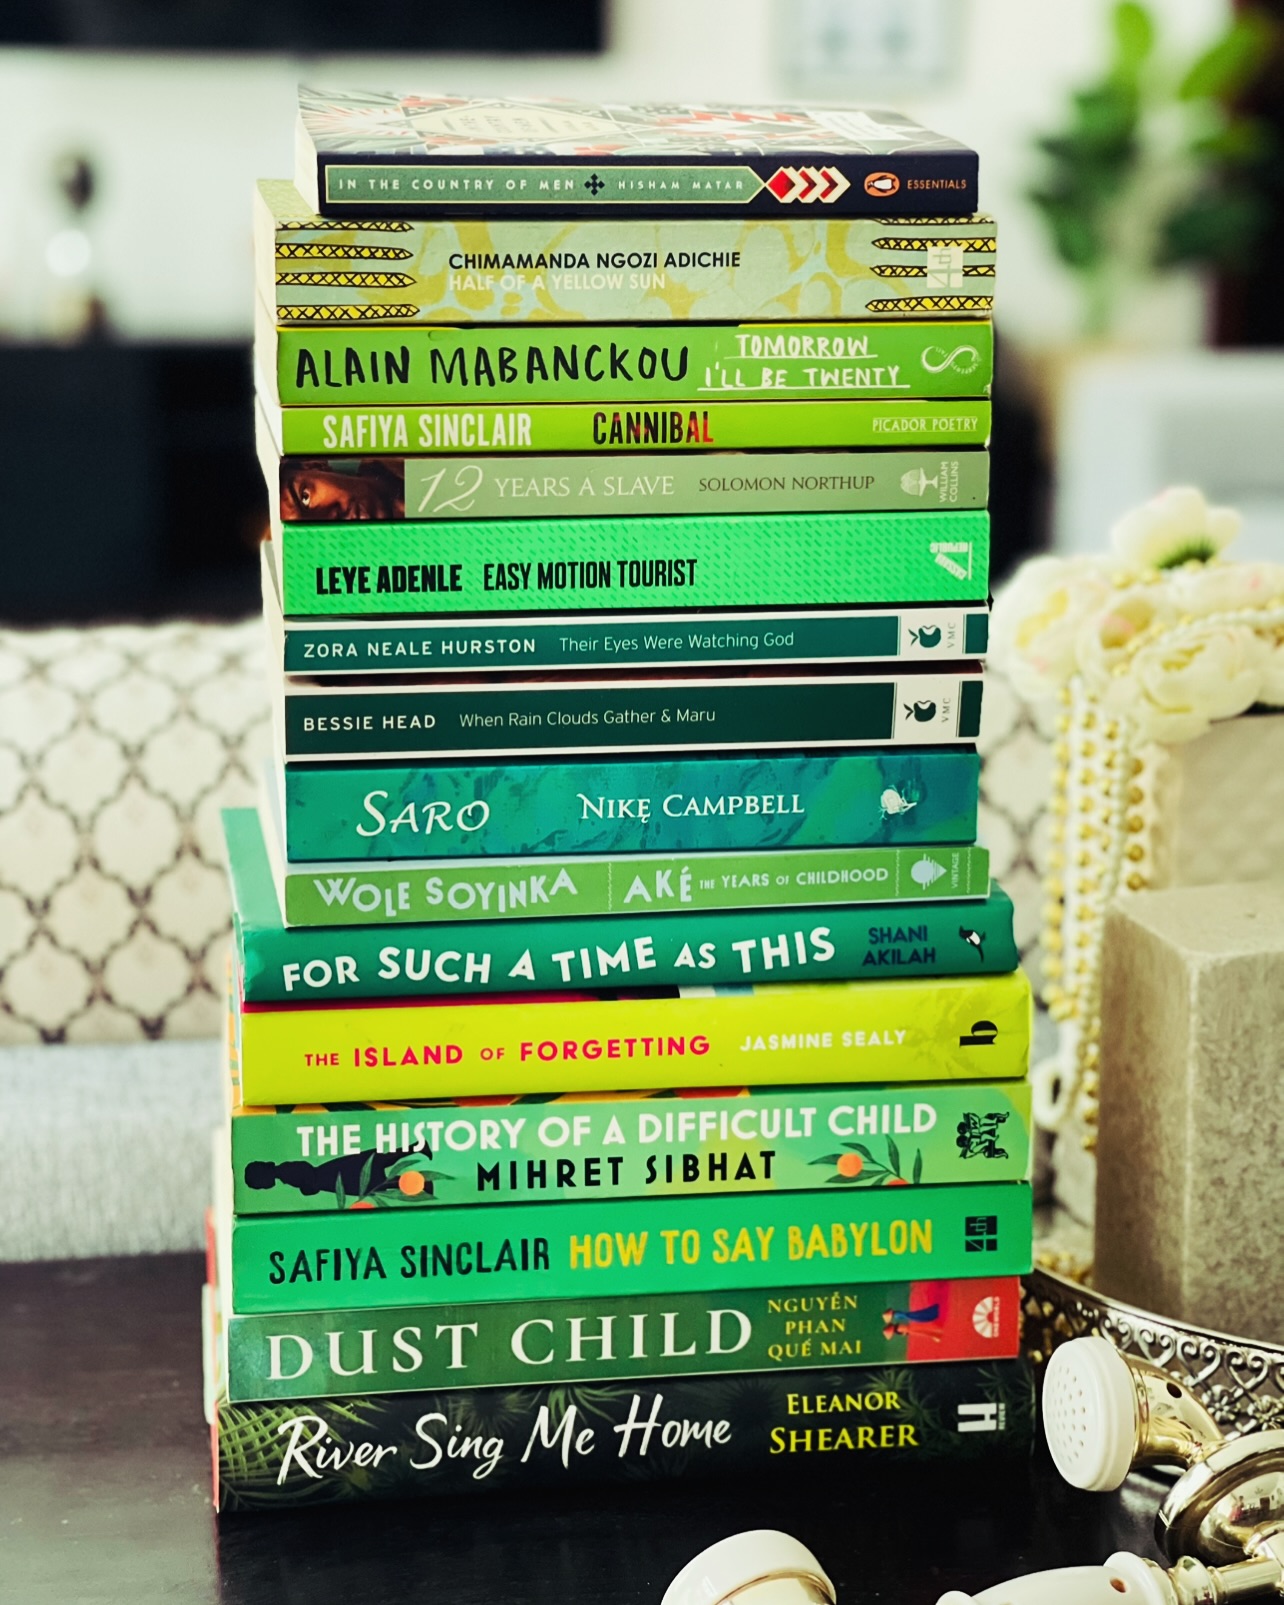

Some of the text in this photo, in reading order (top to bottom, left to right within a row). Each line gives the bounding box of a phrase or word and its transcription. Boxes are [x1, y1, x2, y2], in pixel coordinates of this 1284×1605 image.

[339, 179, 574, 190] IN THE COUNTRY OF MEN
[618, 180, 743, 190] HISHAM MATAR
[907, 180, 967, 190] ESSENTIALS
[448, 252, 741, 269] CHIMAMANDA NGOZI ADICHIE
[449, 273, 665, 291] HALF OF A YELLOW SUN
[734, 334, 868, 357] TOMORROW
[296, 342, 688, 388] ALAIN MABANCKOU
[705, 362, 900, 388] I'LL BE TWENTY
[322, 413, 532, 449] SAFIYA SINCLAIR
[593, 411, 714, 444] CANNIBAL
[872, 417, 977, 432] PICADOR POETRY
[417, 465, 674, 512] 12 YEARS A SLAVE
[699, 476, 875, 492] SOLOMON NORTHUP
[939, 461, 949, 503] WILLIAM
[949, 461, 959, 503] COLLINS
[316, 564, 463, 595] LEYE ADENLE
[484, 560, 698, 591] EASY MOTION TOURIST
[304, 639, 535, 658] ZORA NEALE HURSTON
[560, 632, 794, 654] Their Eyes Were Watching God
[304, 715, 436, 731] BESSIE HEAD
[460, 709, 715, 727] When Rain Clouds Gather & Maru
[662, 794, 805, 817] CAMPBELL
[951, 852, 960, 888] VINTAGE
[312, 868, 578, 917] WOLE SOYINKA
[624, 866, 888, 903] AKÉ THE YEARS OF CHILDHOOD
[869, 926, 928, 944] SHANI
[283, 927, 835, 992] FOR SUCH A TIME AS THIS
[862, 948, 936, 967] AKILAH
[305, 1035, 710, 1067] THE ISLAND OF FORGETTING
[740, 1030, 906, 1052] JASMINE SEALY
[297, 1103, 937, 1157] THE HISTORY OF A DIFFICULT CHILD
[477, 1150, 775, 1191] MIHRET SIBHAT
[569, 1219, 932, 1266] HOW TO SAY BABYLON
[269, 1238, 550, 1284] SAFIYA SINCLAIR
[786, 1318, 846, 1335] PHAN
[265, 1310, 752, 1381] DUST CHILD
[821, 1340, 861, 1355] MAI
[787, 1391, 901, 1415] ELEANOR
[276, 1394, 732, 1485] River Sing Me Home
[769, 1424, 919, 1454] SHEARER
